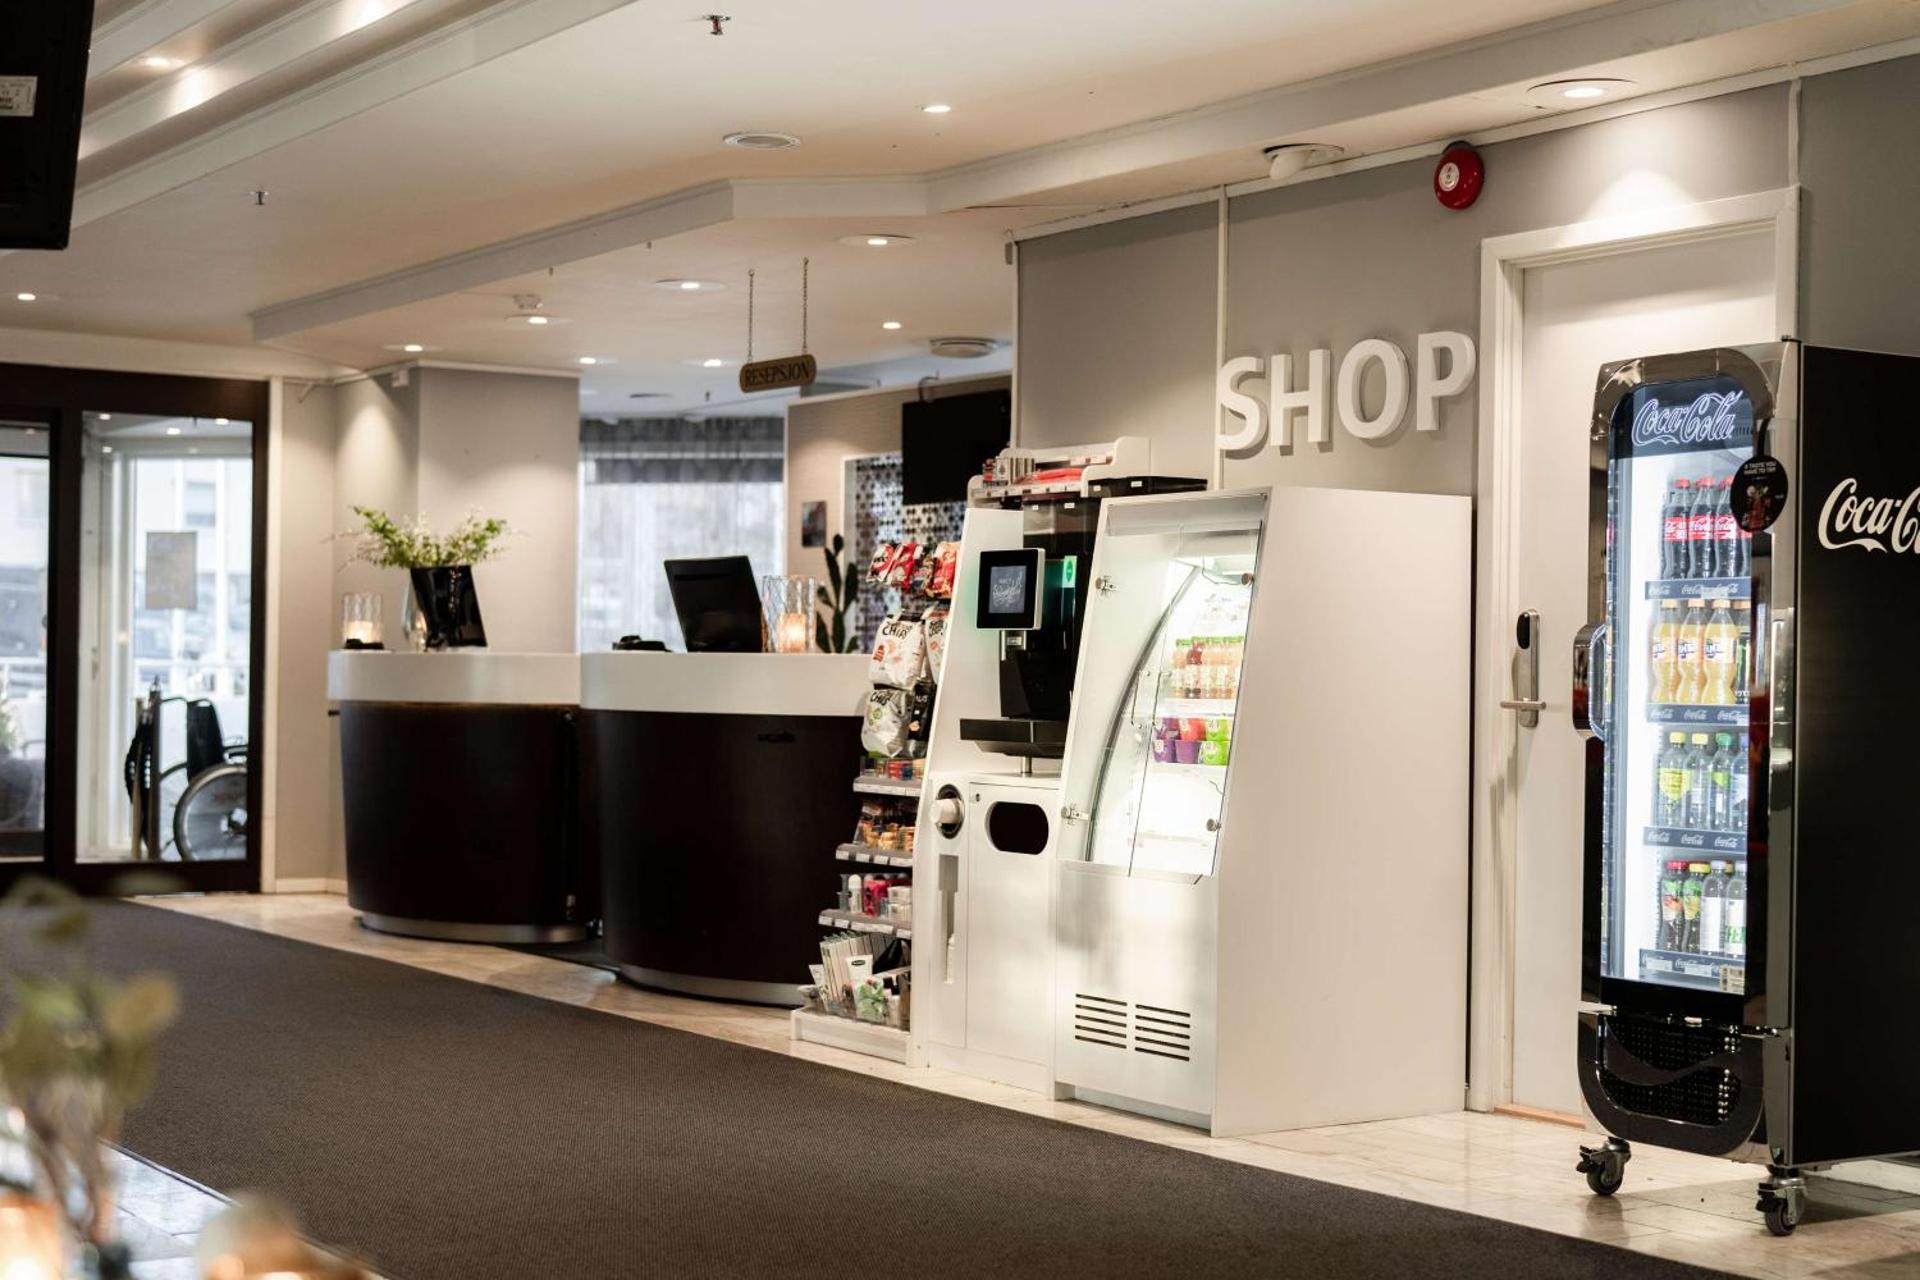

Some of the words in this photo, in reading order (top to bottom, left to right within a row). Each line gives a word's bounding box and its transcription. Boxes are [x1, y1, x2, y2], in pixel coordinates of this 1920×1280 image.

[745, 361, 810, 387] RESEPSJON
[1217, 331, 1476, 450] SHOP
[1631, 390, 1743, 446] Coca-Cola
